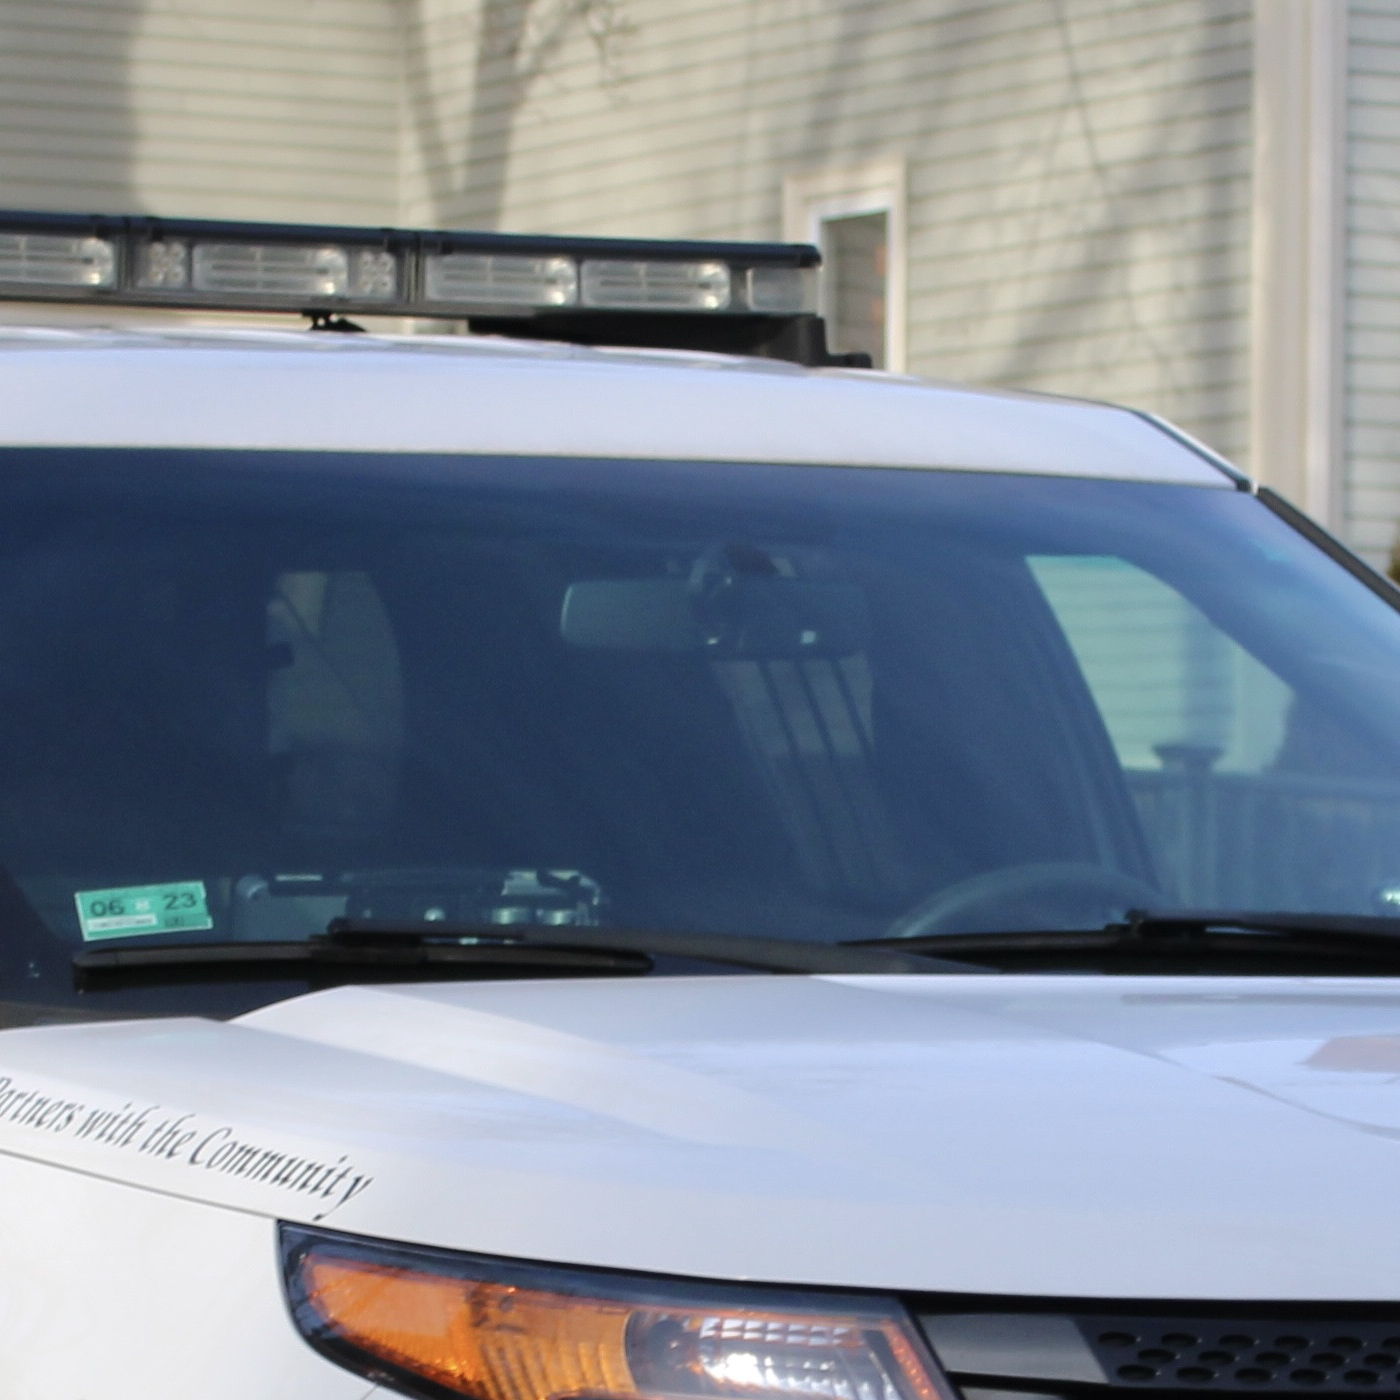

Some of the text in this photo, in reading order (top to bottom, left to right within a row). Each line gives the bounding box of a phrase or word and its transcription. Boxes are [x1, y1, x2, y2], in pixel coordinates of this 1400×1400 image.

[90, 892, 197, 917] 06 23
[74, 1102, 161, 1147] with
[140, 1114, 196, 1160] the
[188, 1127, 375, 1221] Community
